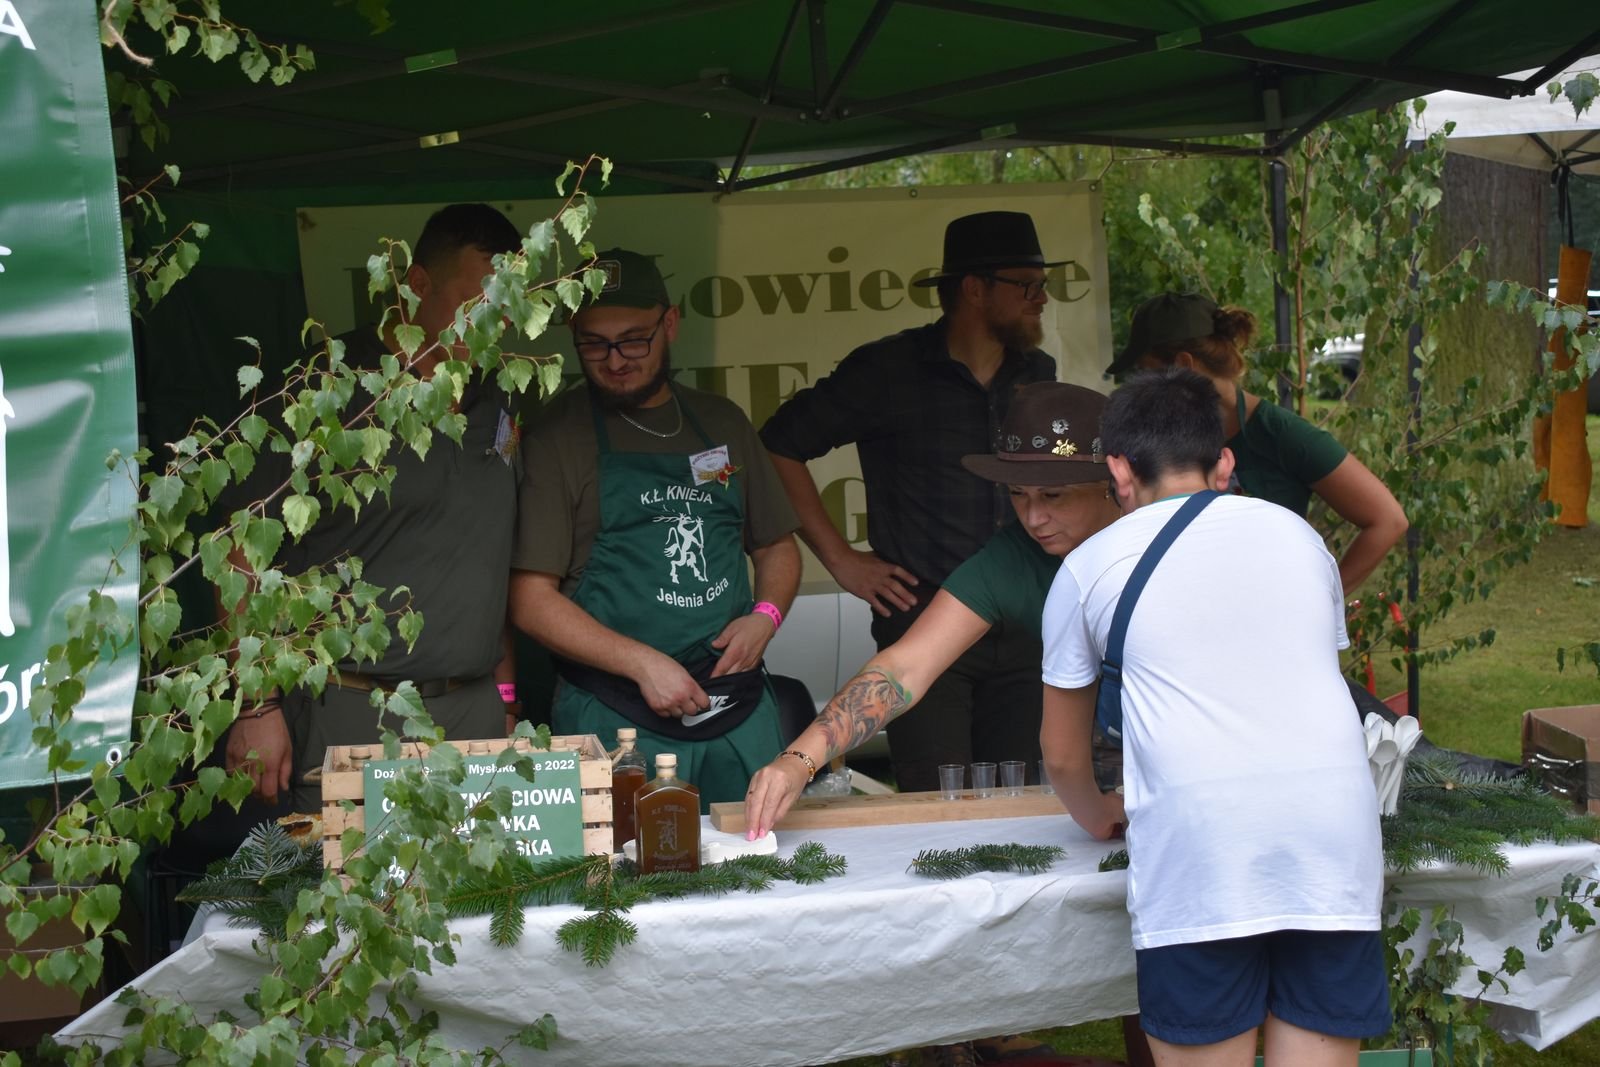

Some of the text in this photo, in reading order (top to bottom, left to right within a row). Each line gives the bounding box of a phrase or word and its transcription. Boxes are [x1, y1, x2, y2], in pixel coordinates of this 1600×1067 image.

[667, 485, 713, 505] KNIEJA
[656, 577, 729, 608] Jelenia Góra
[544, 759, 575, 771] 2022
